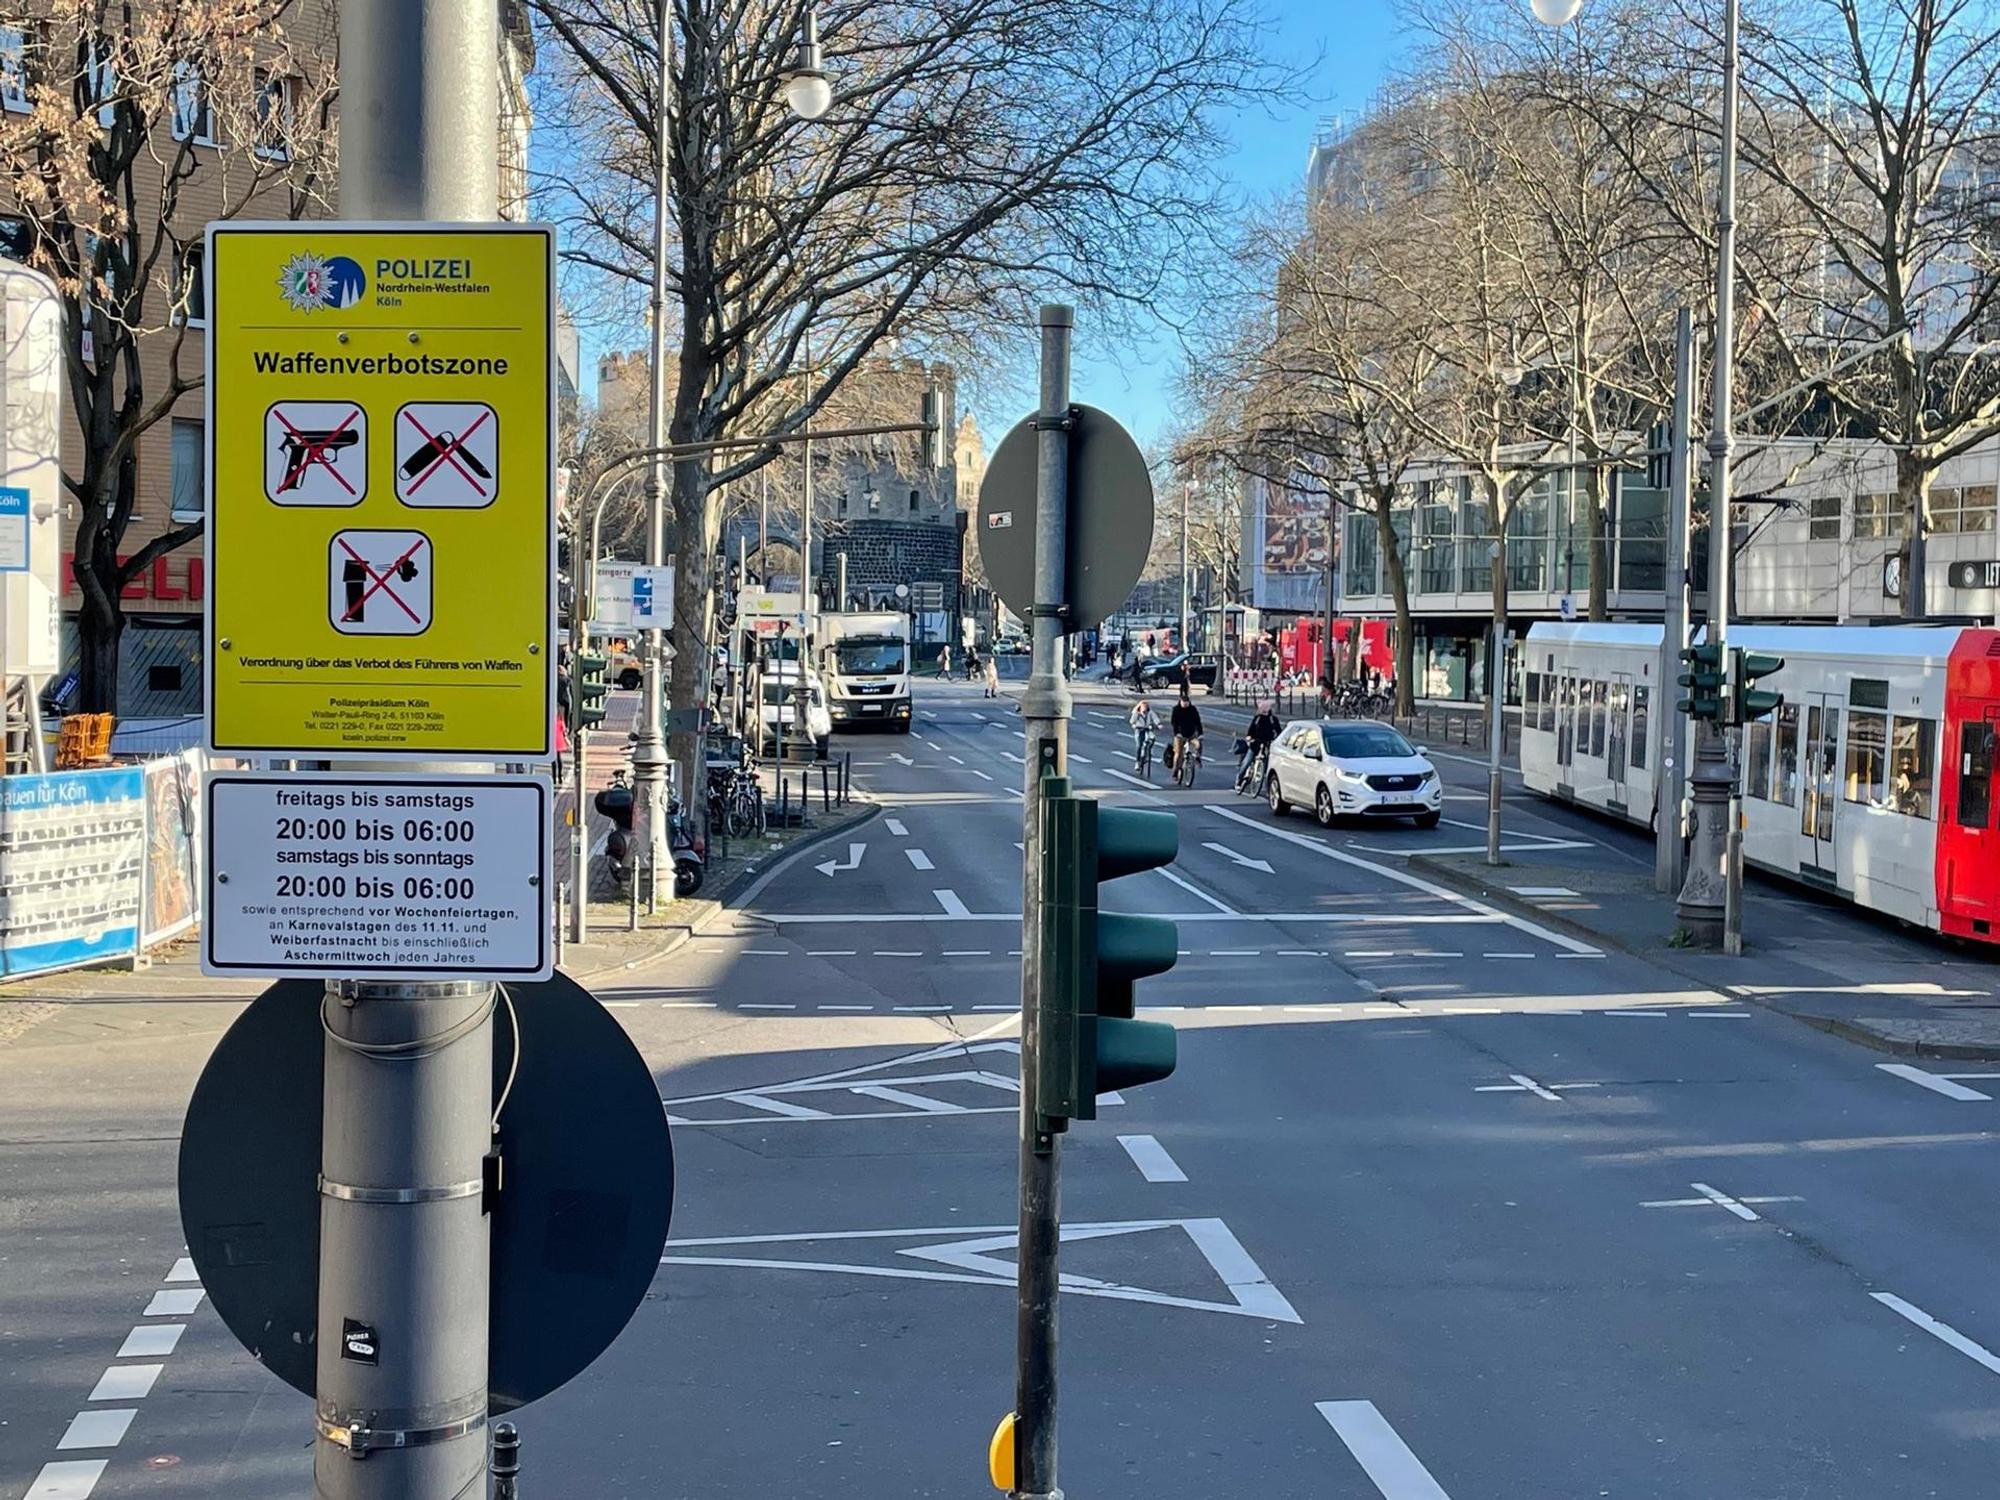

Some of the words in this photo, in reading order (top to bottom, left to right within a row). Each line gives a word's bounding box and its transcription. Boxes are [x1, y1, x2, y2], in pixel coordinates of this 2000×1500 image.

[377, 260, 471, 278] POLIZEI
[377, 284, 489, 294] Nordrhein-Westfalen
[377, 297, 401, 306] Köln
[254, 353, 508, 375] Waffenverbotszone
[240, 657, 303, 670] Verordnung
[306, 657, 330, 668] über
[333, 658, 352, 668] das
[356, 659, 390, 669] Verbot
[392, 659, 412, 669] des
[415, 659, 459, 670] Führens
[462, 662, 482, 670] von
[486, 661, 522, 670] Waffen
[330, 698, 406, 708] Polizeipräsidium
[408, 700, 429, 708] Köln
[38, 783, 57, 803] für
[276, 791, 345, 809] freitags
[352, 792, 378, 807] bis
[385, 792, 474, 811] samstags
[276, 818, 345, 840] 20:00
[356, 819, 393, 840] bis
[404, 821, 474, 842] 06:00
[276, 850, 358, 867] samstags
[364, 850, 389, 864] bis
[394, 852, 474, 868] sonntags
[276, 876, 345, 897] 20:00
[356, 877, 393, 898] bis
[404, 878, 474, 899] 06:00
[242, 906, 276, 915] sowie
[281, 906, 364, 918] entsprechend
[369, 908, 391, 916] vor
[395, 906, 518, 920] Wochenfeiertagen,
[269, 922, 284, 930] an
[289, 920, 390, 933] Karnevalstagen
[395, 922, 417, 932] des
[422, 923, 459, 933] 11.11.
[464, 923, 486, 933] und
[271, 935, 377, 946] Weiberfastnacht
[382, 936, 399, 947] bis
[404, 936, 489, 948] einschließlich
[285, 951, 390, 962] Aschermittwoch
[394, 952, 428, 963] jeden
[433, 952, 475, 963] Jahres
